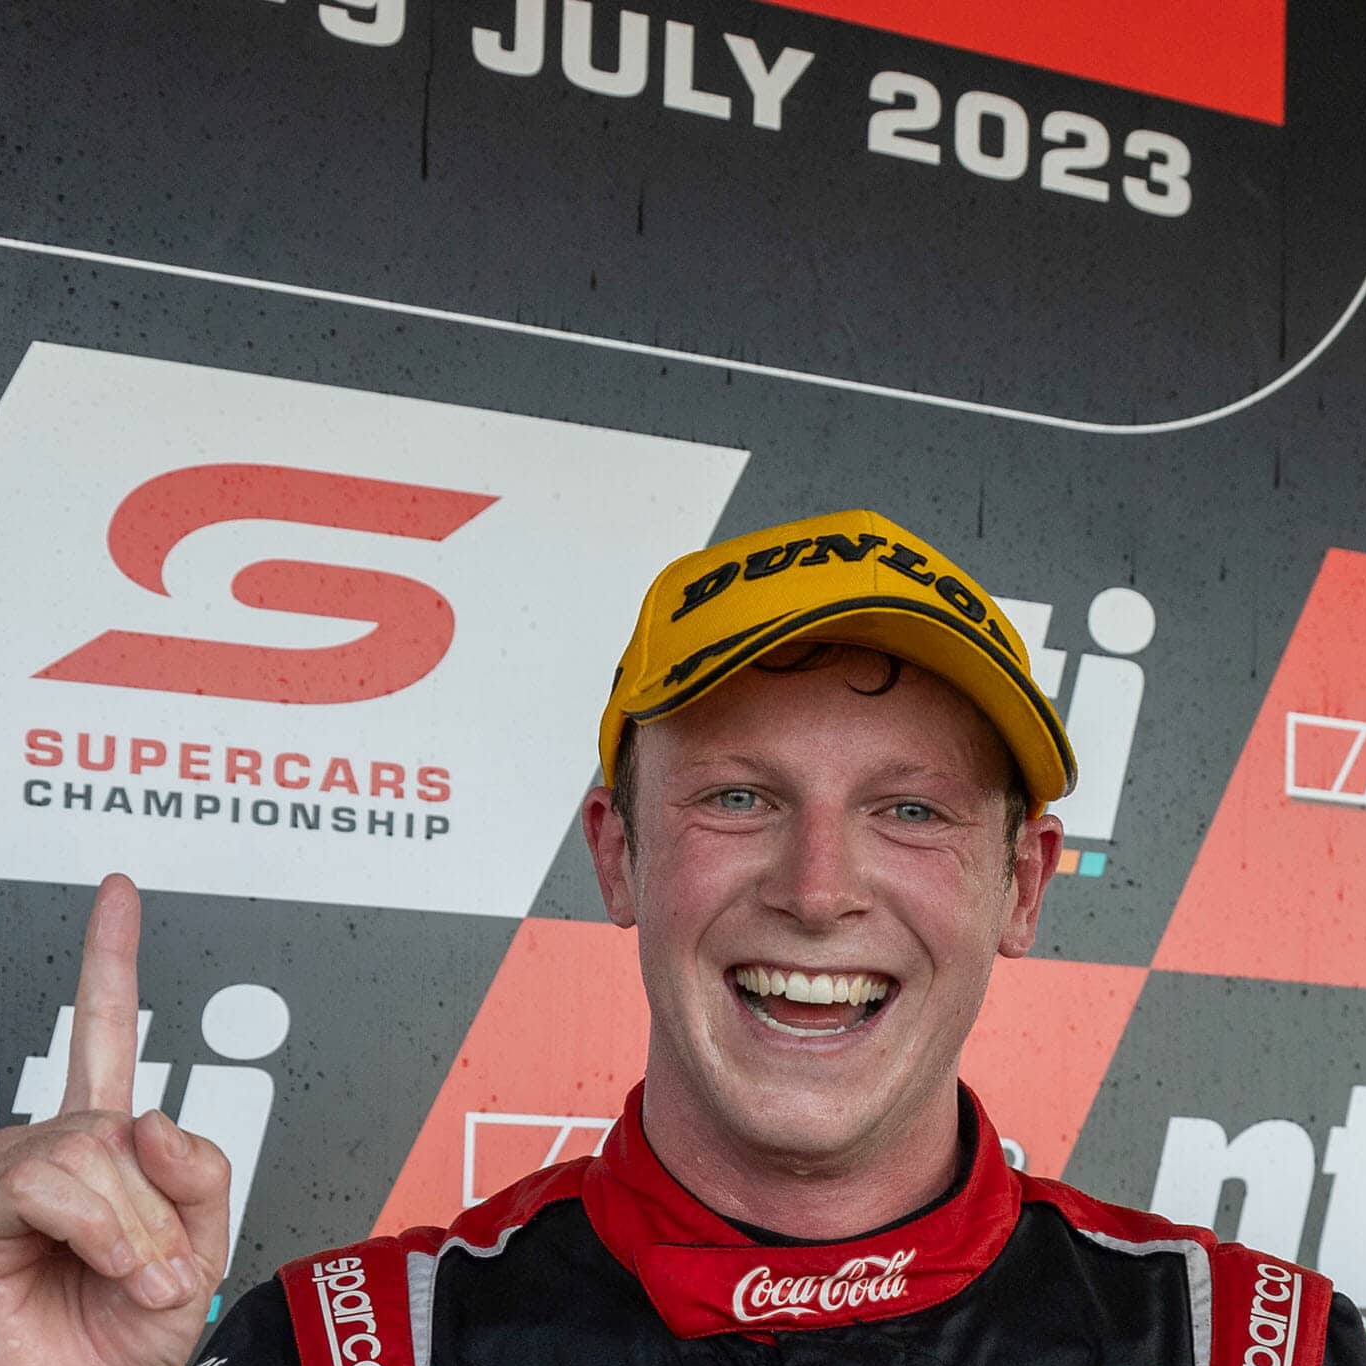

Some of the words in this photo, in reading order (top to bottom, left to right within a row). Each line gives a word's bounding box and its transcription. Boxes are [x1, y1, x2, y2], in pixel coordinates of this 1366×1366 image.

[472, 0, 814, 131] JULY
[867, 71, 1192, 217] 2023
[24, 728, 452, 803] SUPERCARS
[22, 778, 452, 841] CHAMPIONSHIP
